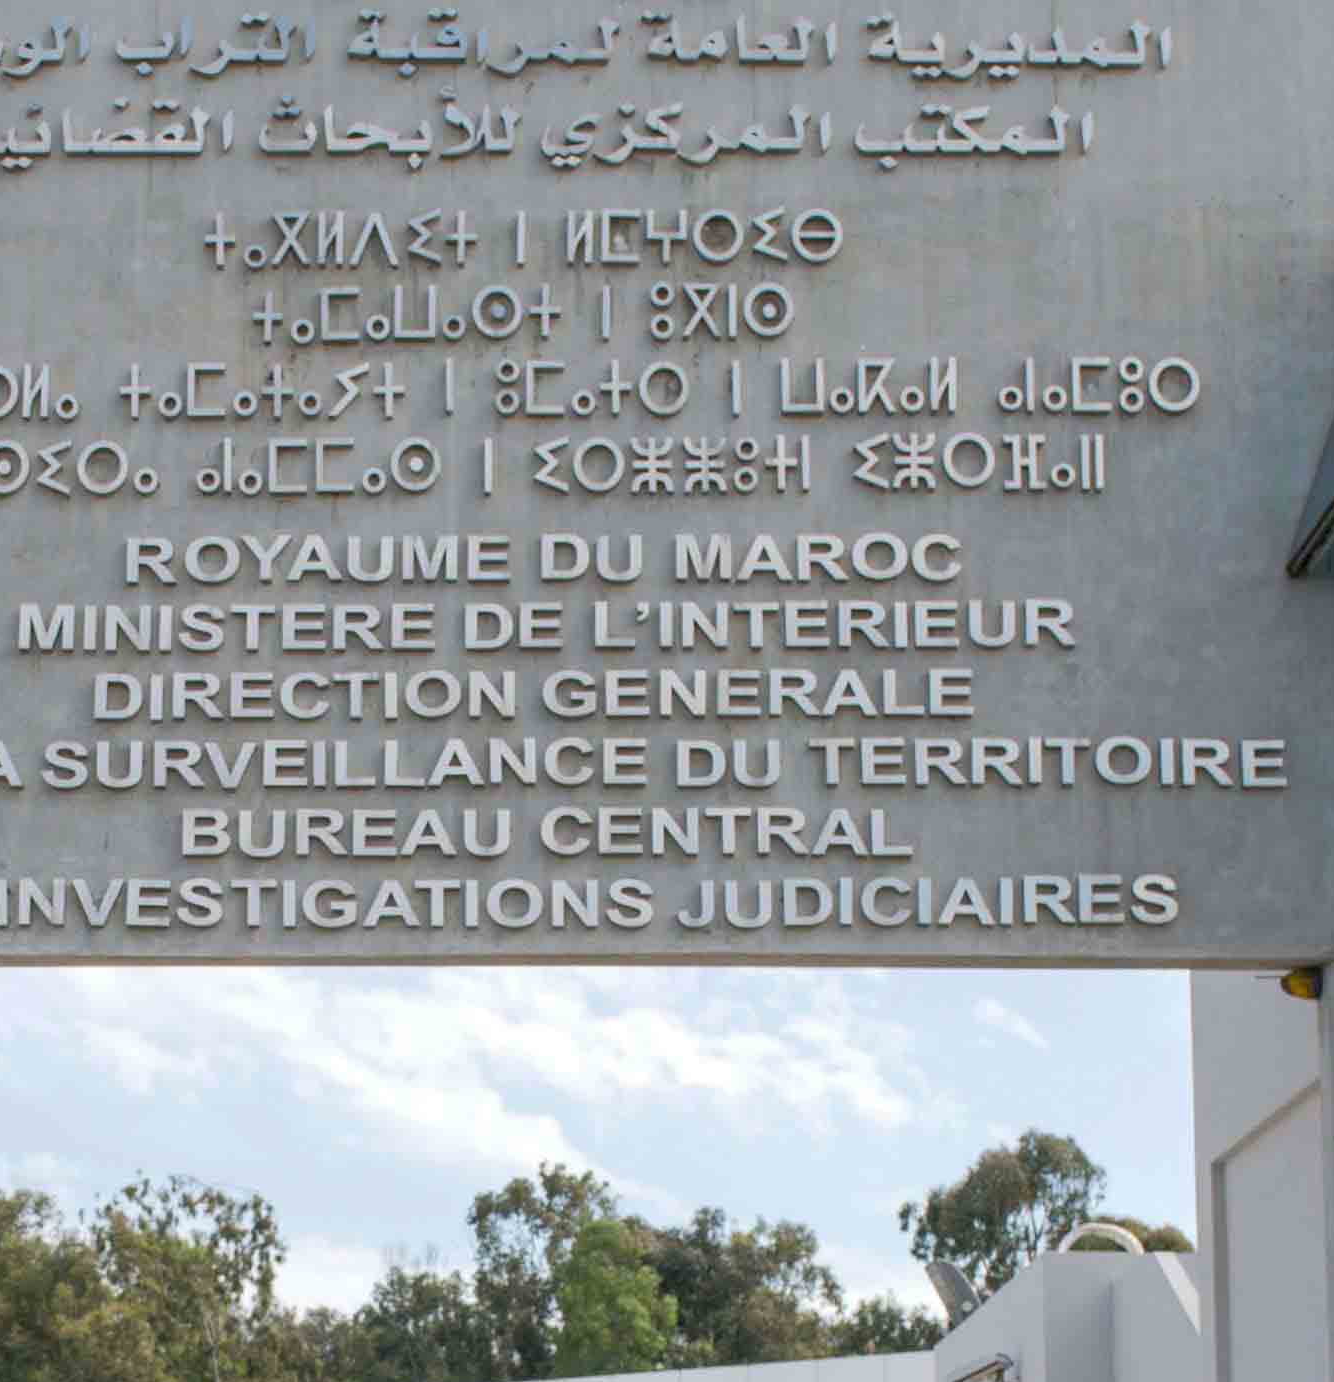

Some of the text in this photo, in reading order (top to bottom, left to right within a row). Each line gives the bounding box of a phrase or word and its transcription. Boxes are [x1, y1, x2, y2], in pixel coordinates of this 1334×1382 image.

[113, 12, 318, 80] التراب
[347, 8, 620, 78] لمراقبة
[639, 14, 837, 66] العامة
[865, 12, 1173, 80] المديرية
[257, 86, 521, 170] للأبحاث
[539, 103, 833, 169] المركزي
[854, 102, 1097, 170] المكتب
[123, 532, 964, 586] ROYAUME DU MAROC
[16, 604, 436, 654] MINISTERE
[462, 602, 565, 652] DE
[91, 668, 976, 723] DIRECTION GENERALE
[39, 738, 647, 791] SURVEILLANCE
[675, 740, 784, 788] DU
[809, 737, 1287, 790] TERRITOIRE
[180, 806, 914, 860] BUREAU CENTRAL
[676, 874, 1181, 928] JUDICIAIRES
